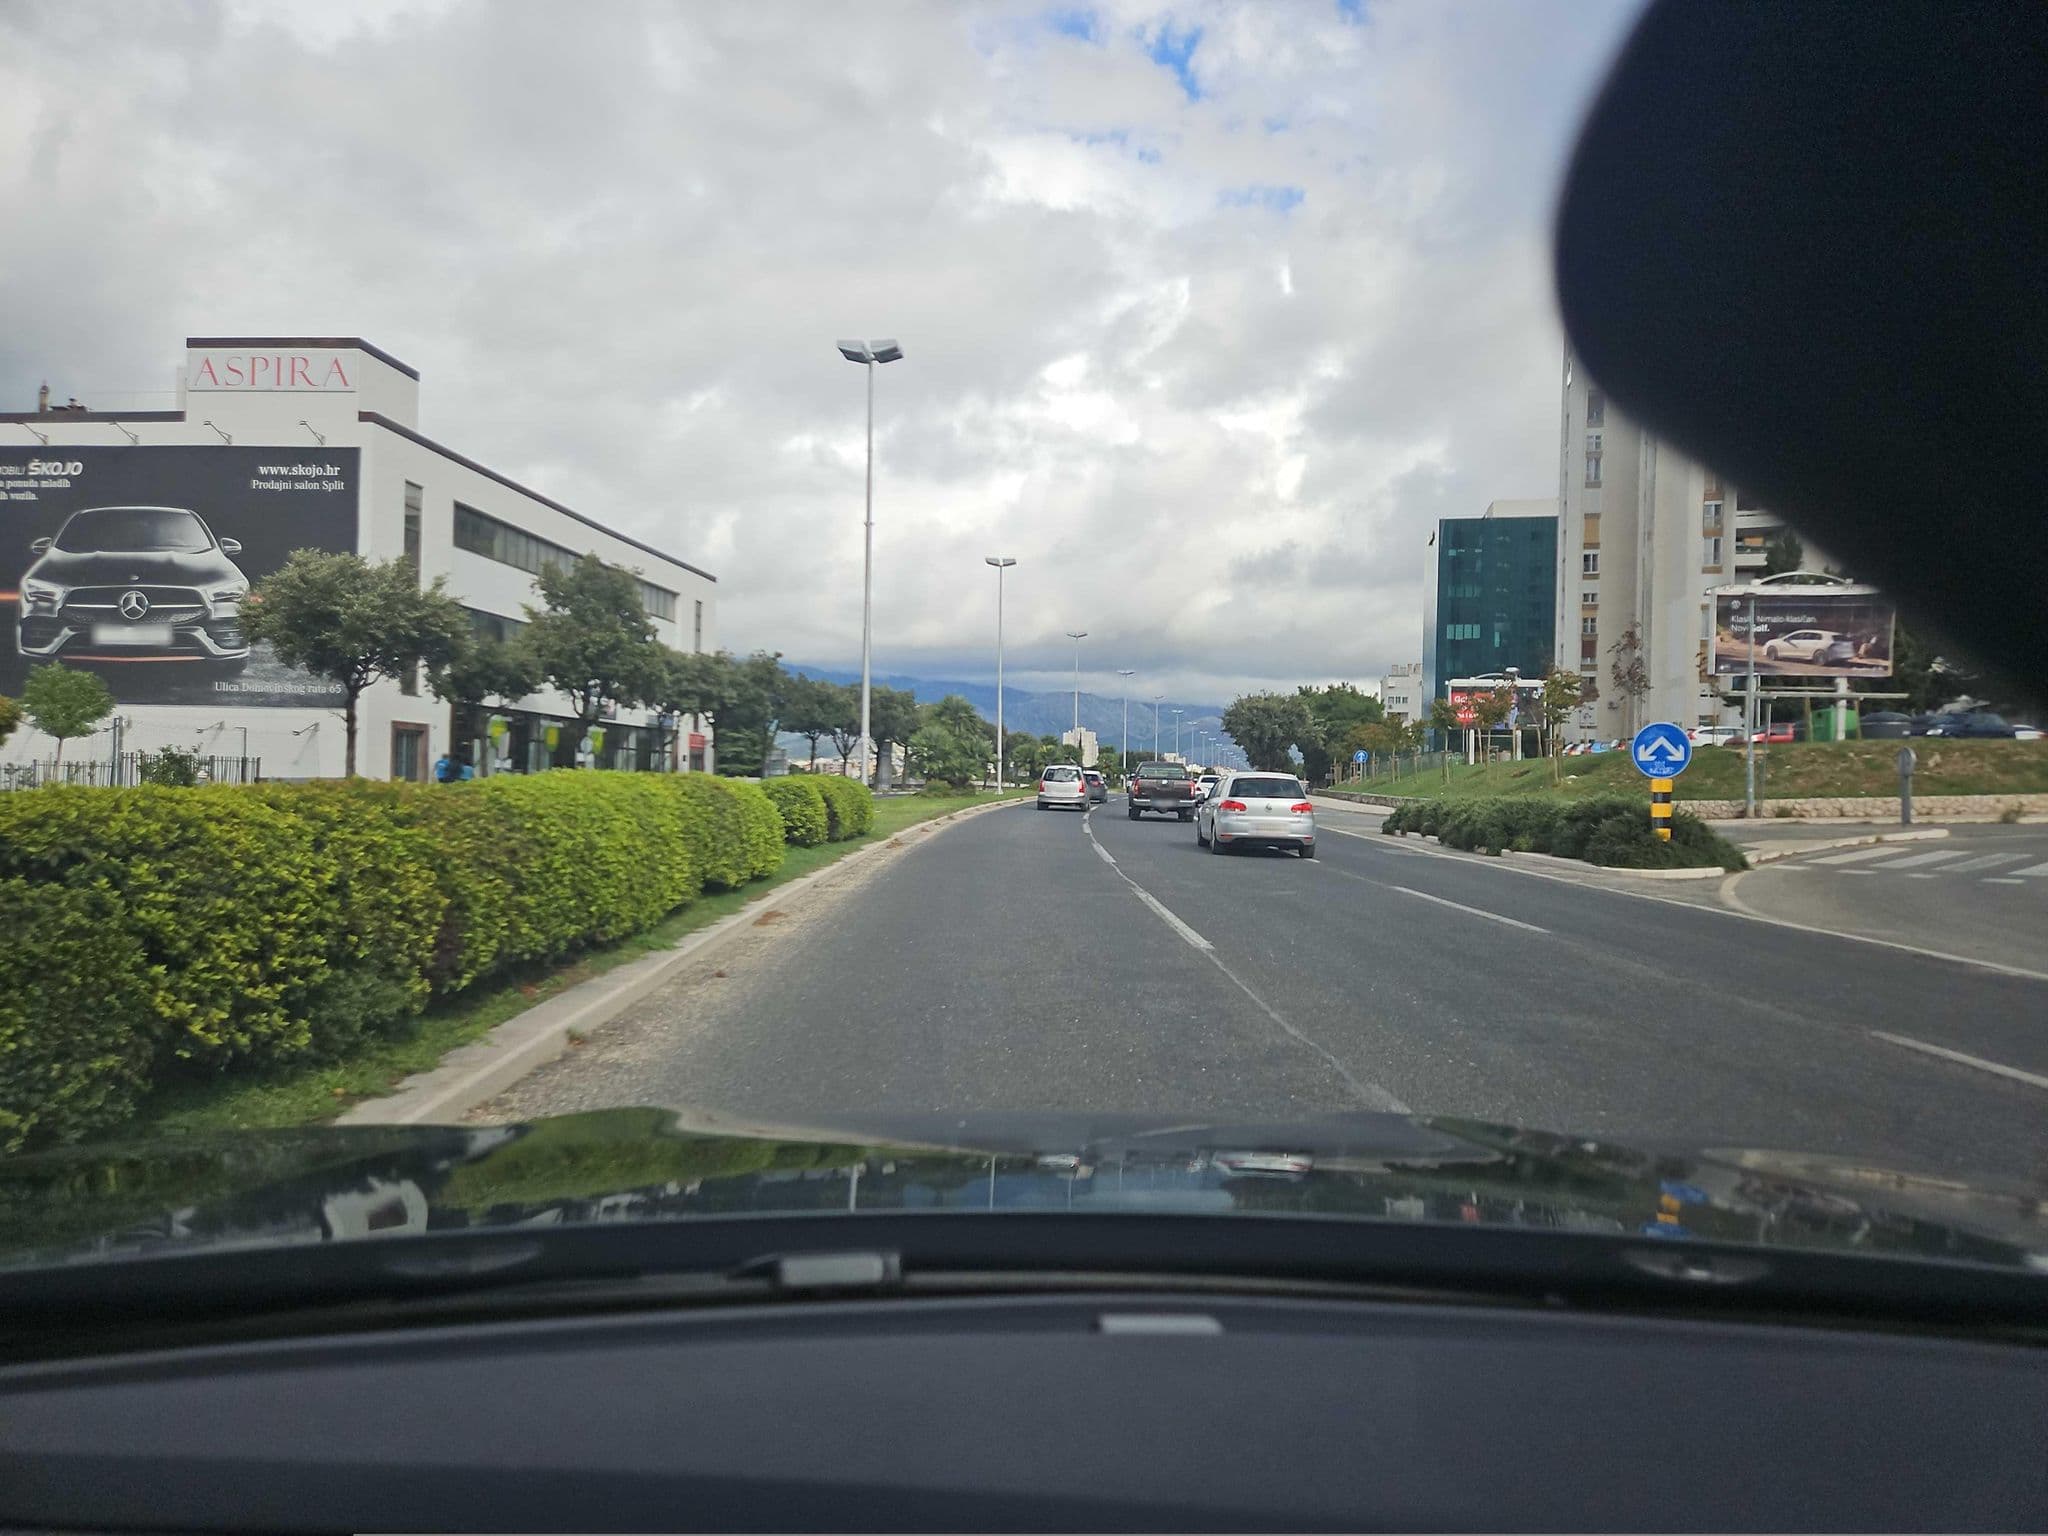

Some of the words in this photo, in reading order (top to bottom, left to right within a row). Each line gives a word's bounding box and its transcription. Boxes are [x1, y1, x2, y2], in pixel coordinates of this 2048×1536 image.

[194, 356, 349, 387] ASPIRA
[28, 458, 83, 475] ŠKOJO
[259, 464, 341, 478] www.skojo.hr
[252, 479, 292, 491] Prodajni
[294, 480, 320, 490] salon
[322, 480, 345, 492] Split
[215, 681, 239, 692] Ulica
